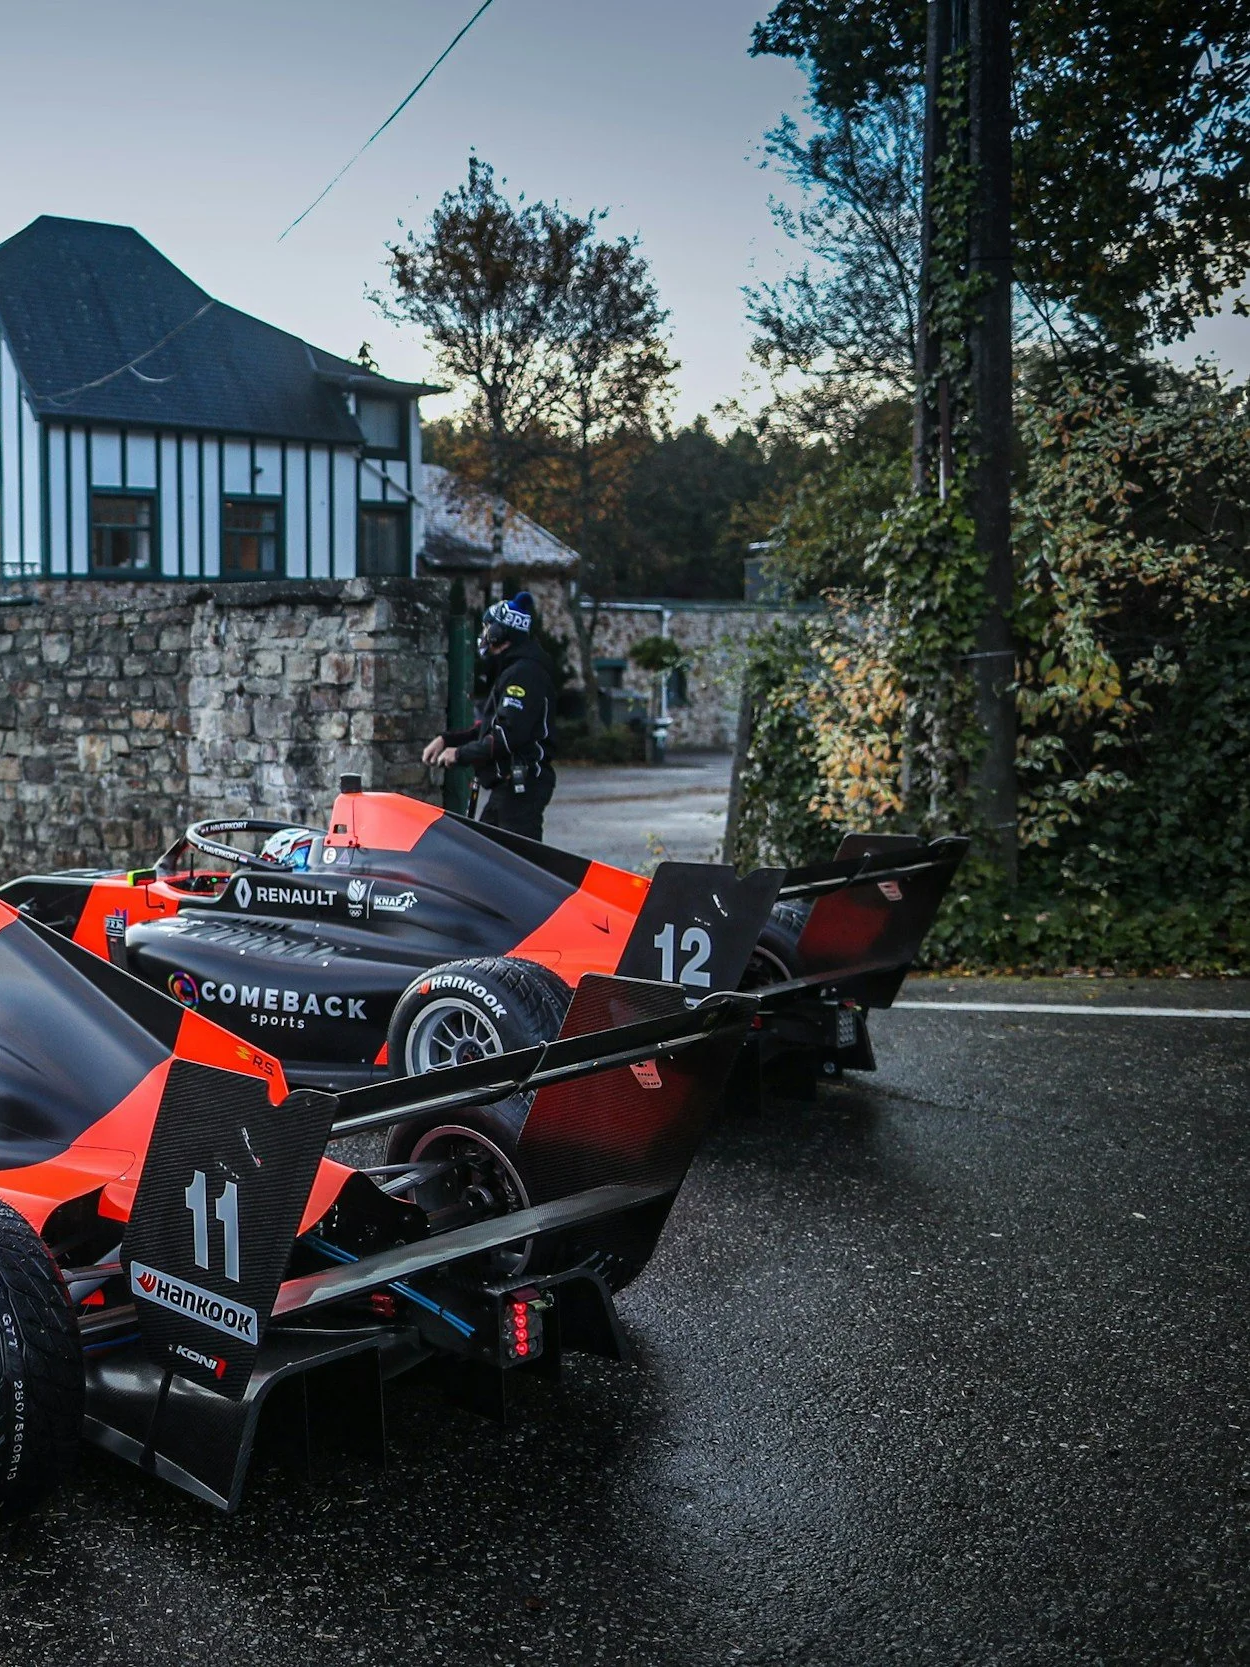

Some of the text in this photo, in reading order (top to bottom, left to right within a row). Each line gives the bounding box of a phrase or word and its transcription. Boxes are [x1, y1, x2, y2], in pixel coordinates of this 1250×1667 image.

[210, 821, 248, 832] HAVERKORT
[256, 886, 337, 906] RENAULT
[375, 896, 403, 907] KNAF
[653, 922, 712, 988] 12
[201, 980, 368, 1021] COMEBACK
[430, 975, 507, 1019] Hankook
[250, 1012, 306, 1030] sports
[184, 1169, 240, 1283] 11
[157, 1278, 253, 1337] Hankook
[175, 1344, 218, 1370] KONI
